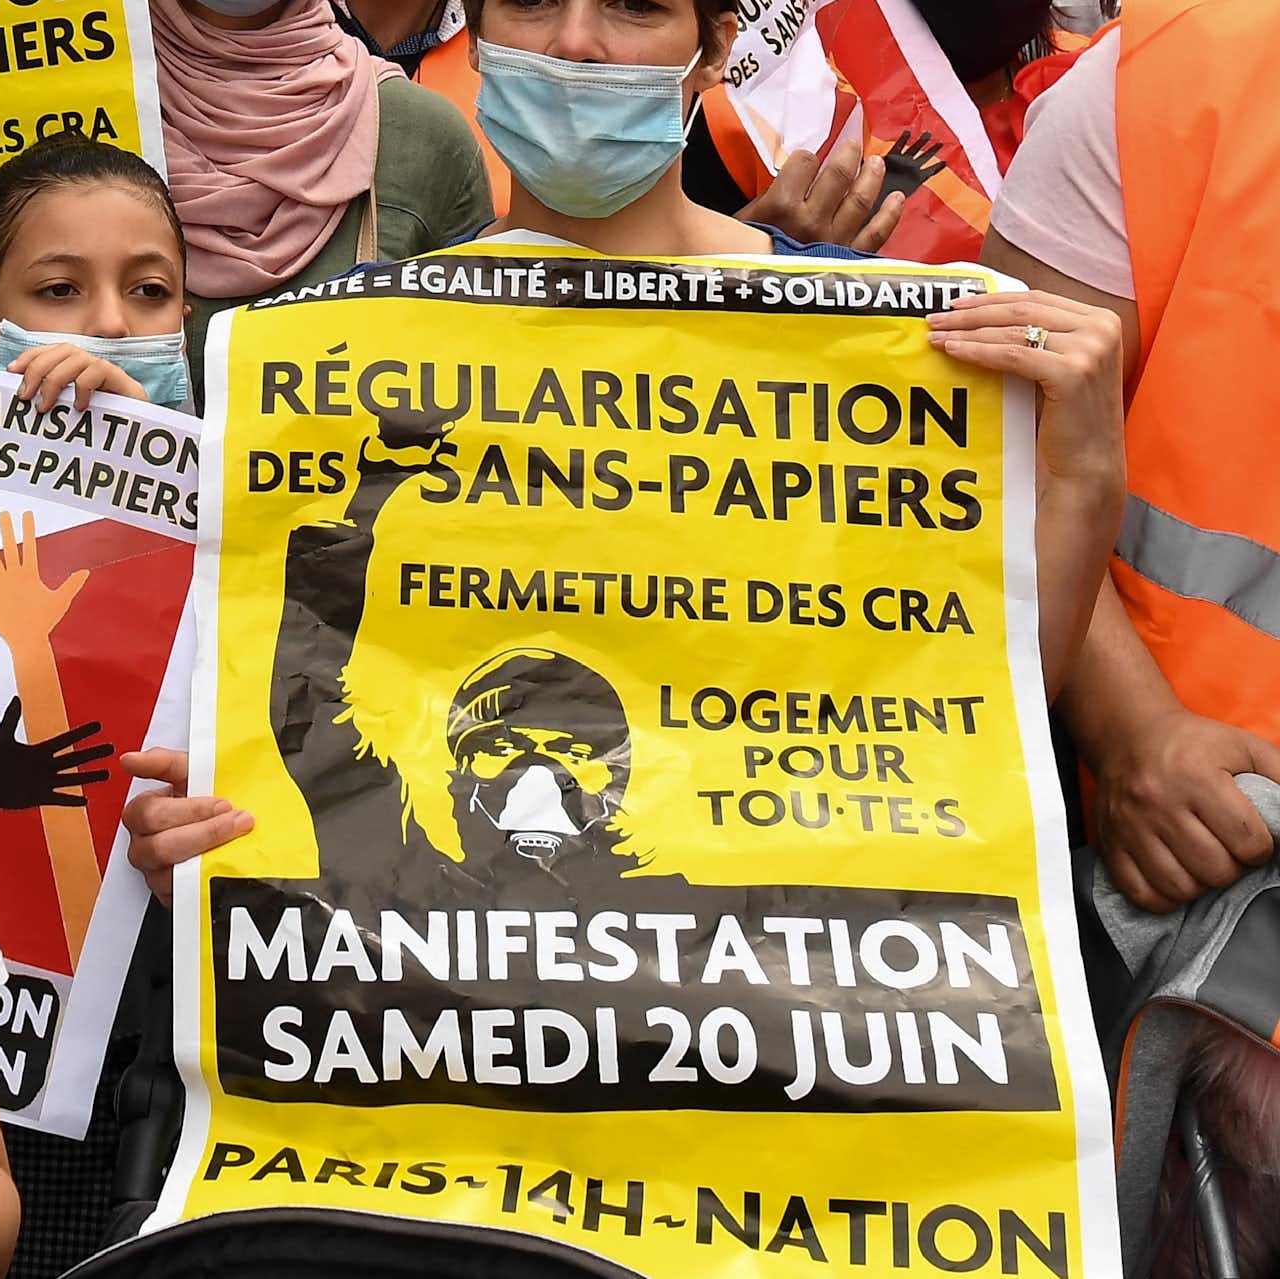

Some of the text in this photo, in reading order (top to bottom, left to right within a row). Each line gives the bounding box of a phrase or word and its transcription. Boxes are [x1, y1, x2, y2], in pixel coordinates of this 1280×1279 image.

[729, 52, 760, 89] DES
[253, 271, 365, 308] SANTÉ
[400, 261, 547, 298] ÉGALITÉ
[584, 269, 725, 303] LIBERTÉ
[259, 341, 969, 450] RÉGULARISATION
[248, 442, 984, 532] DES SANS-PAPIERS
[398, 562, 975, 637] FERMETURE DES CRA
[658, 683, 986, 735] LOGEMENT
[743, 743, 912, 785] POUR
[227, 905, 1020, 990] MANIFESTATION
[261, 1004, 1010, 1102] SAMEDI 20 JUIN
